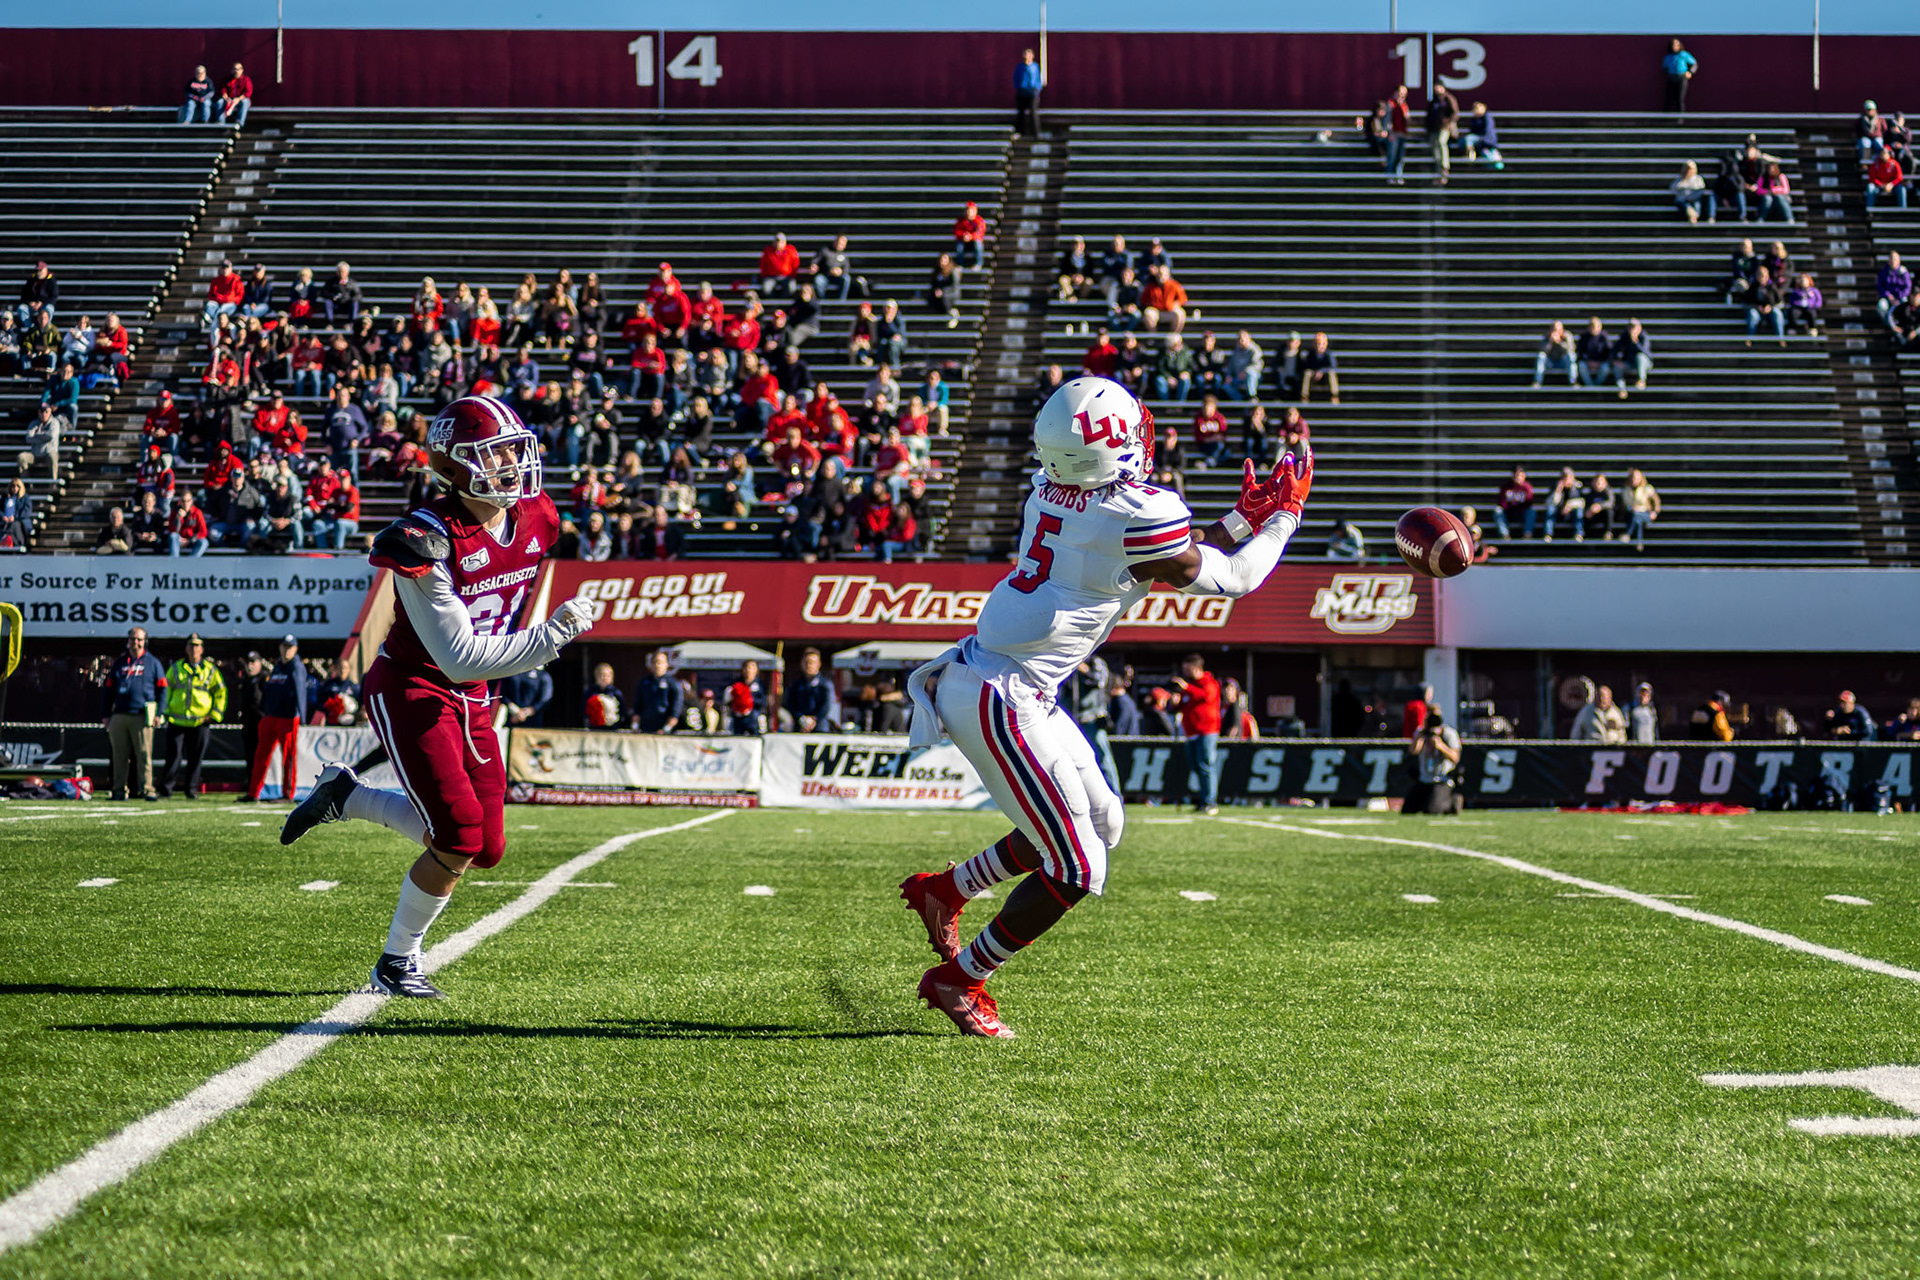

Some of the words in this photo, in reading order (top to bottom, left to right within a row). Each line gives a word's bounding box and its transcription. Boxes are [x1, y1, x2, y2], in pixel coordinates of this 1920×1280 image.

[628, 35, 723, 87] 14
[1396, 38, 1487, 90] 13
[1008, 511, 1064, 594] 5
[21, 572, 97, 589] Source
[106, 573, 143, 590] For
[151, 572, 279, 590] Minuteman
[288, 573, 373, 594] Apparel
[577, 577, 635, 600] GO!
[639, 575, 687, 597] GO
[689, 572, 727, 595] U!
[802, 575, 990, 625] UMAS
[1116, 592, 1235, 627] ING
[611, 592, 745, 621] UMASS!
[803, 743, 911, 779] WEEI
[867, 785, 964, 800] FOOTBALL
